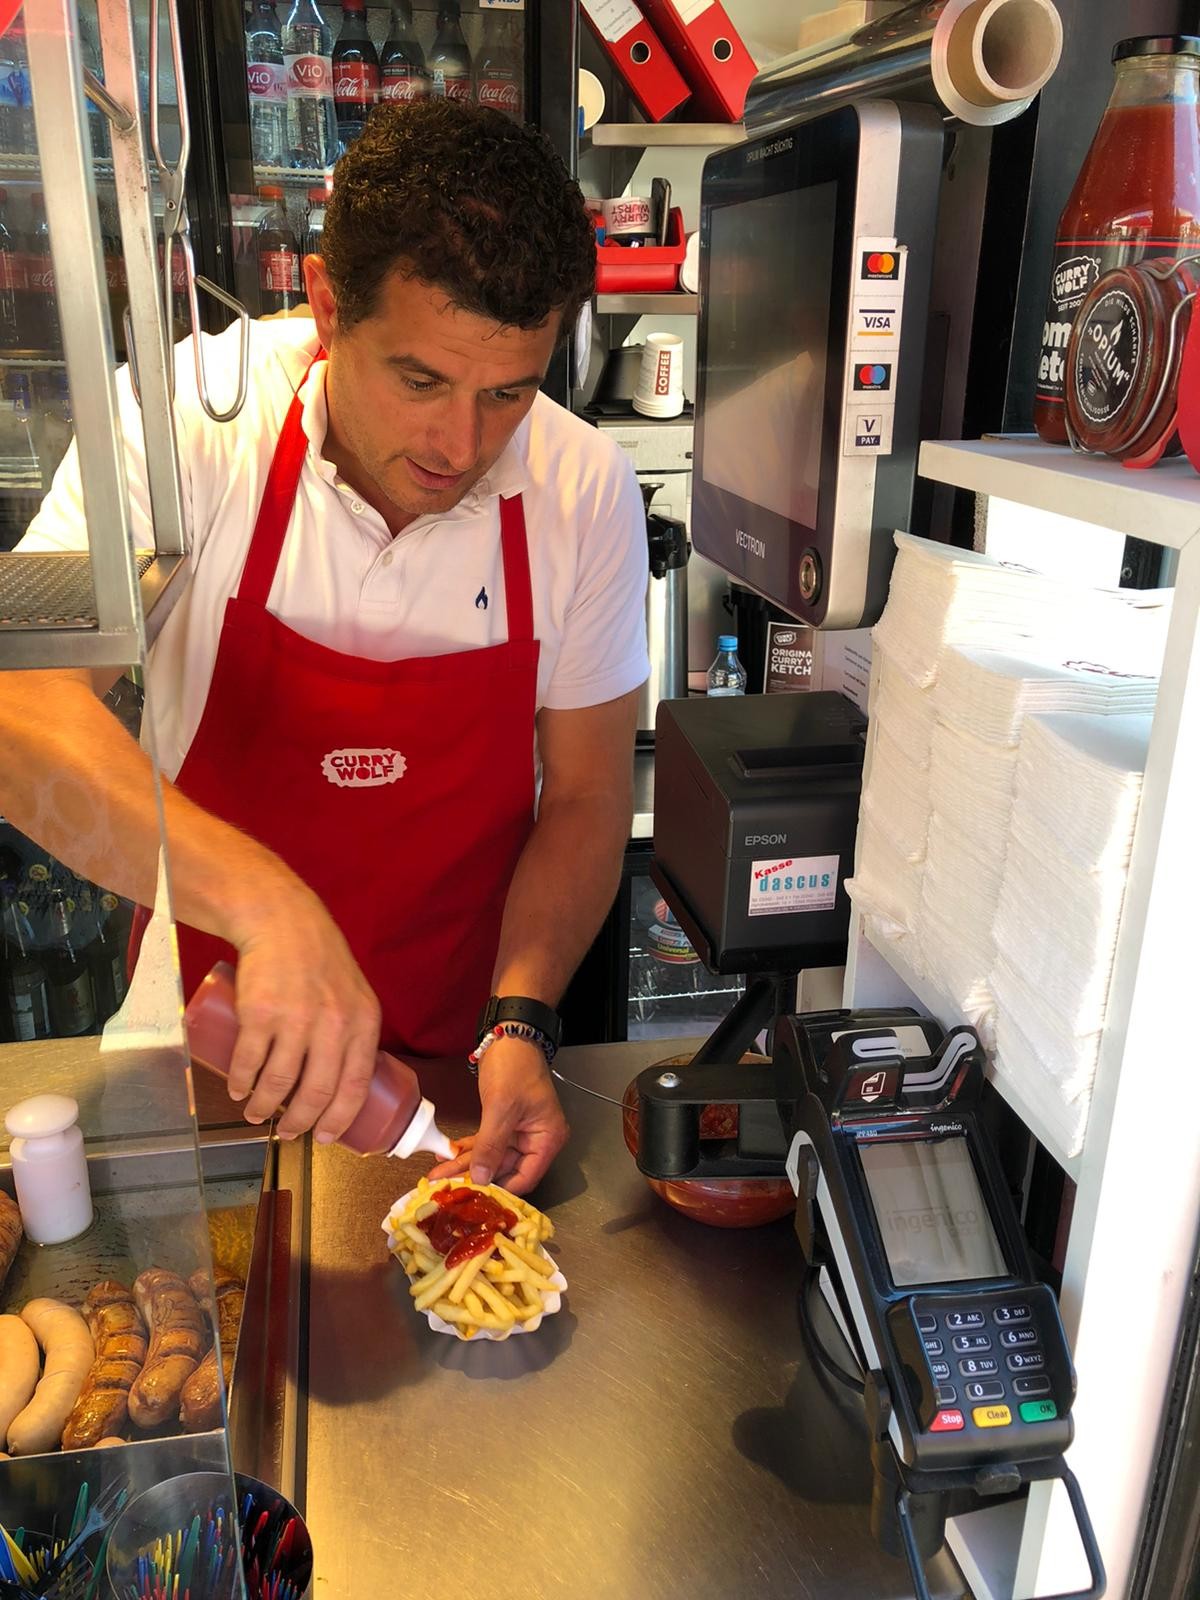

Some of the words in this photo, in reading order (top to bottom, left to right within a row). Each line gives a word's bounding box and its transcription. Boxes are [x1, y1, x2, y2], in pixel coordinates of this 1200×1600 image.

[1056, 263, 1090, 285] CURRY
[1056, 276, 1088, 296] WOLF
[862, 316, 891, 329] VISA
[658, 352, 670, 394] COFFEE
[863, 419, 876, 433] V
[861, 437, 876, 445] PAY
[735, 529, 766, 559] VECTRON
[771, 656, 804, 666] CURRY
[770, 663, 812, 676] KETCH
[330, 753, 397, 768] CURRY
[336, 765, 395, 781] WOLF
[744, 834, 787, 846] EPSON
[754, 859, 794, 880] Kasse
[759, 873, 831, 892] dascus
[930, 1122, 963, 1134] ingenico
[953, 1313, 964, 1325] 2
[966, 1313, 981, 1322] ABC
[1001, 1308, 1011, 1320] 3
[961, 1336, 970, 1348] 5
[1007, 1331, 1017, 1343] 6
[967, 1360, 978, 1372] 8
[979, 1360, 994, 1370] TUV
[1013, 1354, 1024, 1367] 9
[931, 1364, 948, 1373] QRS
[940, 1413, 962, 1425] Stop
[985, 1410, 1009, 1420] Clear
